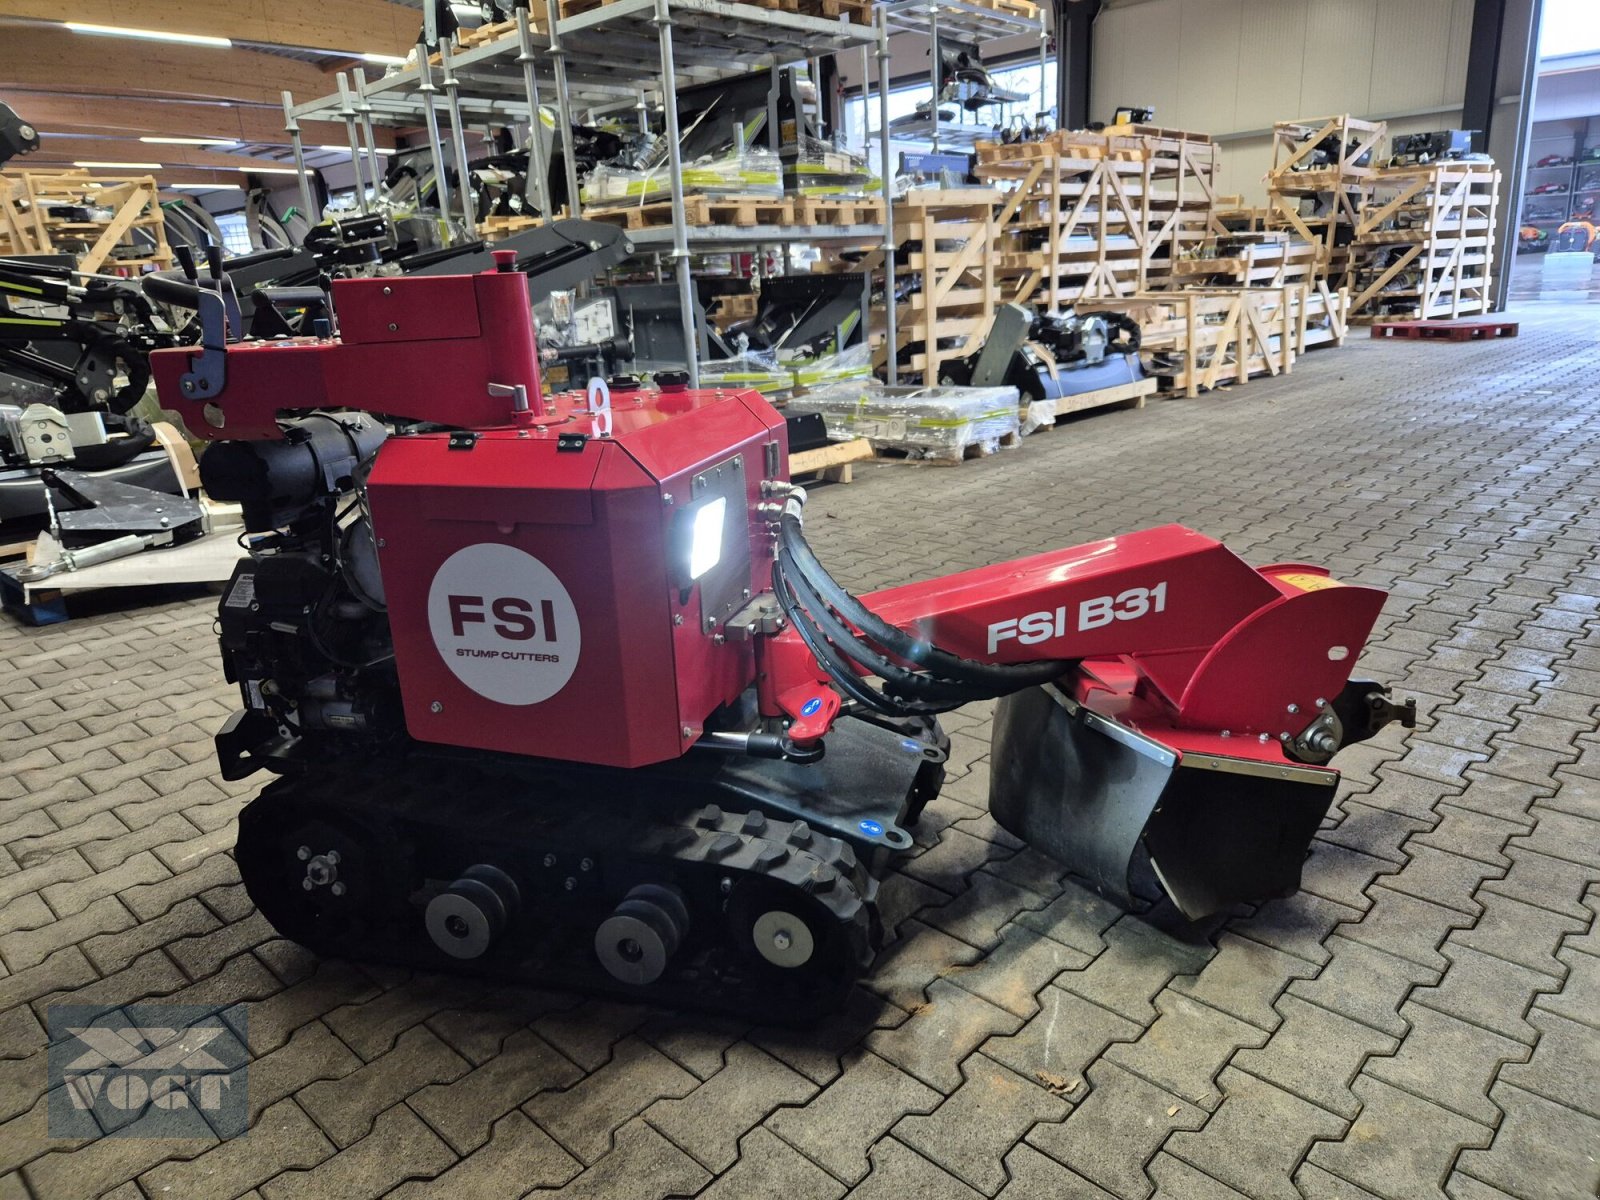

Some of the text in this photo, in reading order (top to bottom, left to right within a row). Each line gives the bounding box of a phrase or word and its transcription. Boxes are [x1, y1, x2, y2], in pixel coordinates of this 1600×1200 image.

[448, 595, 557, 642] FSI
[987, 581, 1167, 655] FSI B31
[456, 649, 559, 662] STUMP CUTTERS
